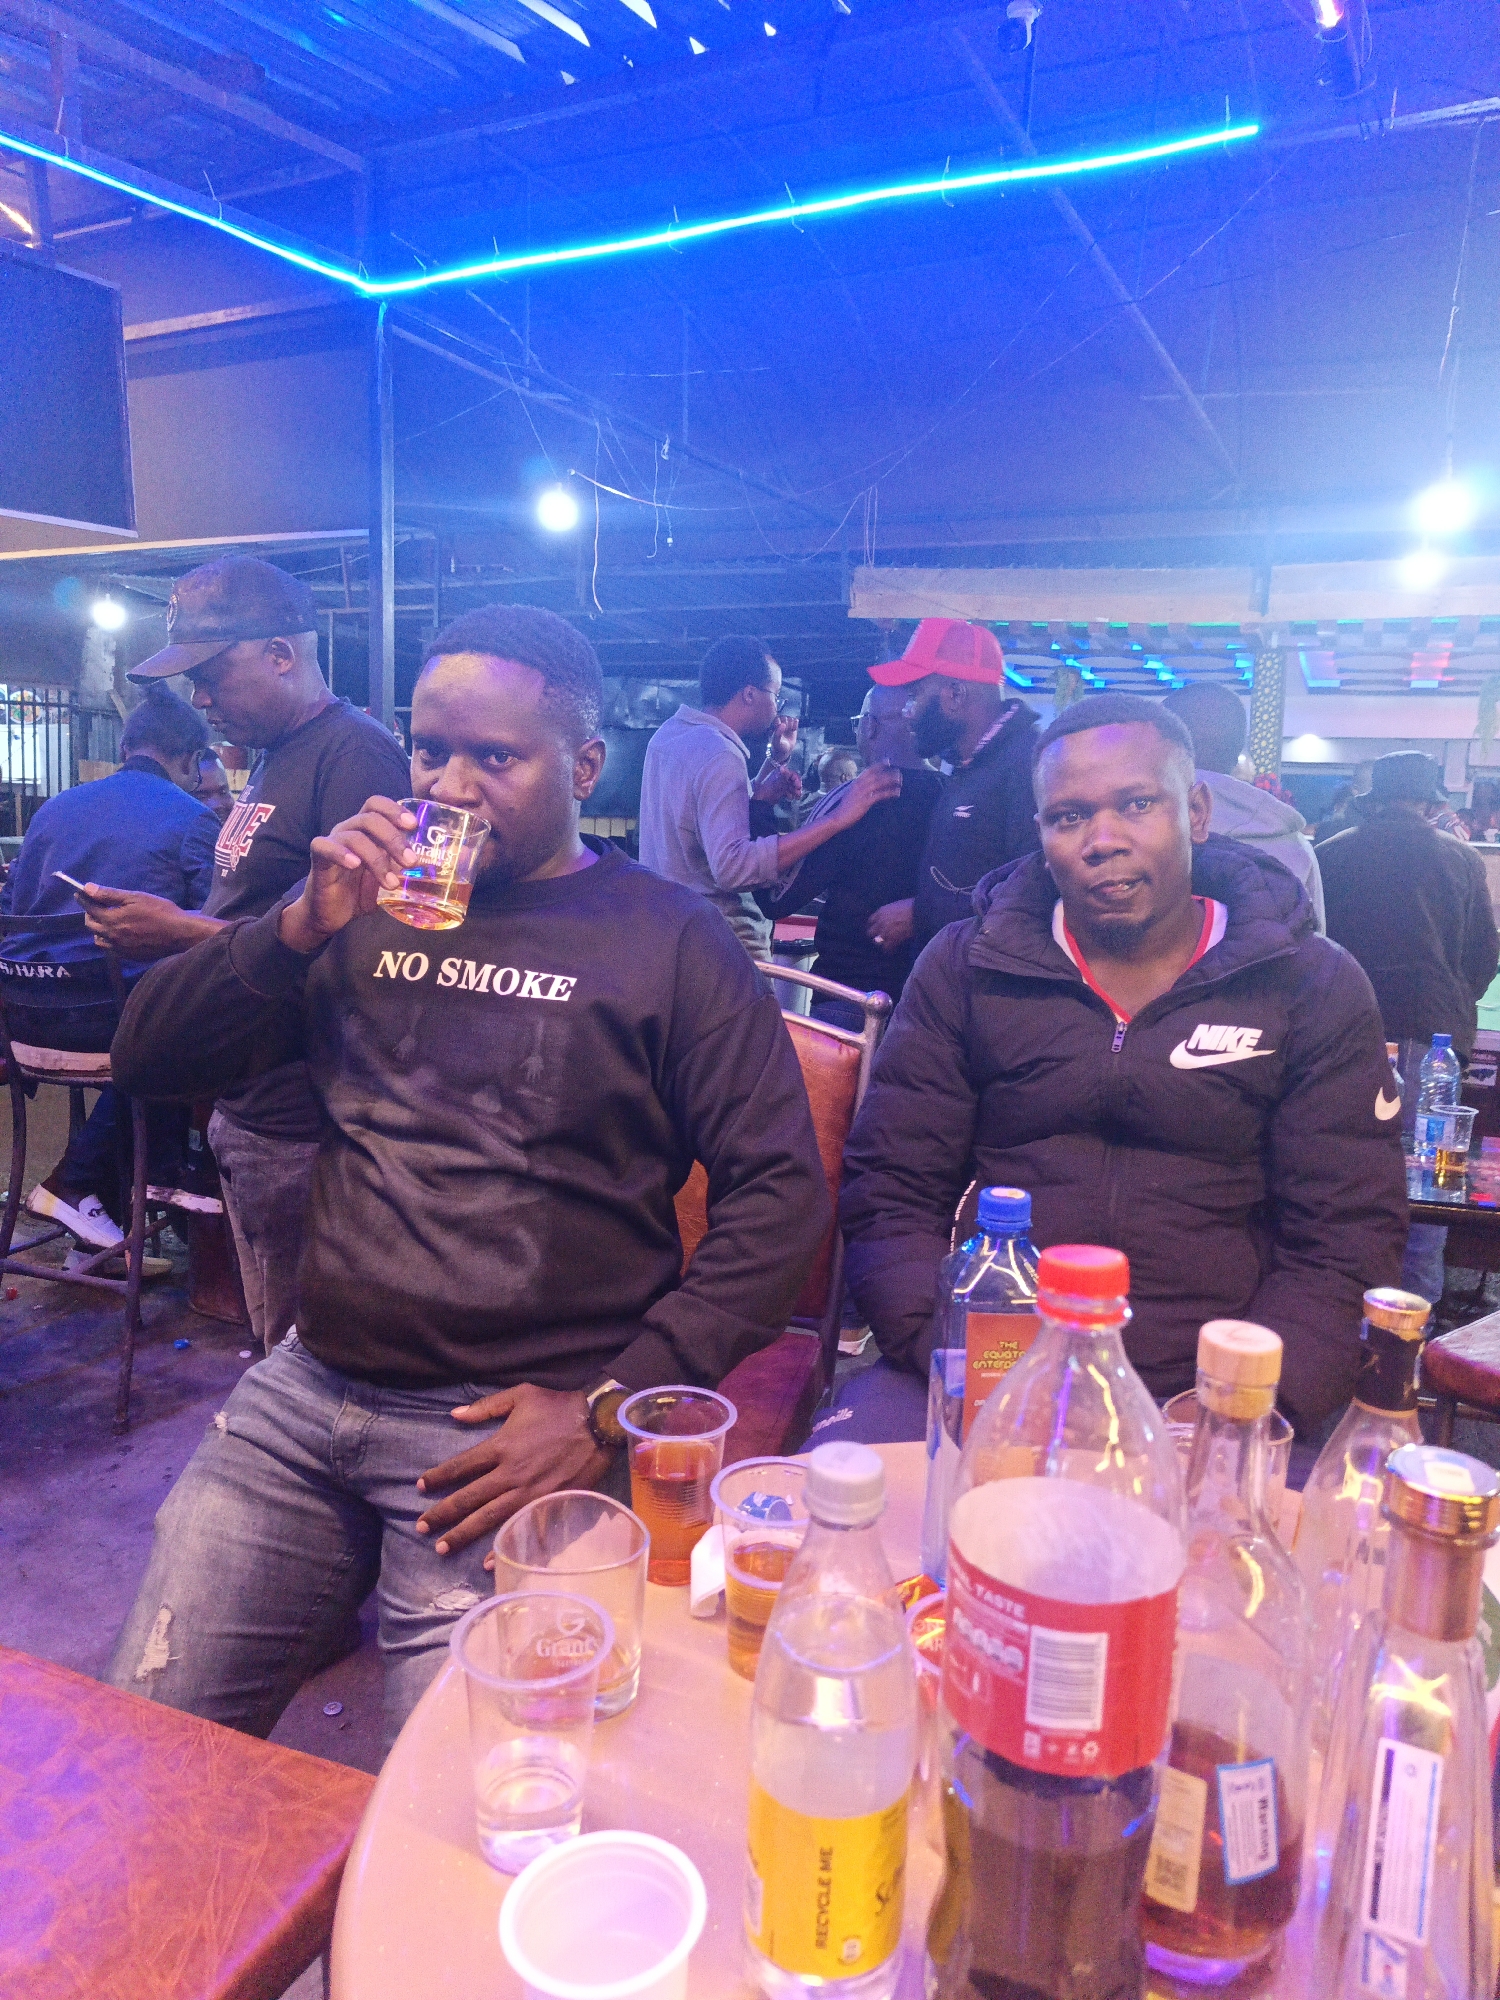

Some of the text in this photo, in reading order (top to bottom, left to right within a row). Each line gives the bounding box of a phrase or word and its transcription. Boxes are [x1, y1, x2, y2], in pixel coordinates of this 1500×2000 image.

[373, 951, 577, 1001] NO SMOKE
[1186, 1023, 1263, 1053] NIKE
[815, 1846, 834, 1950] RECYCLE ME
